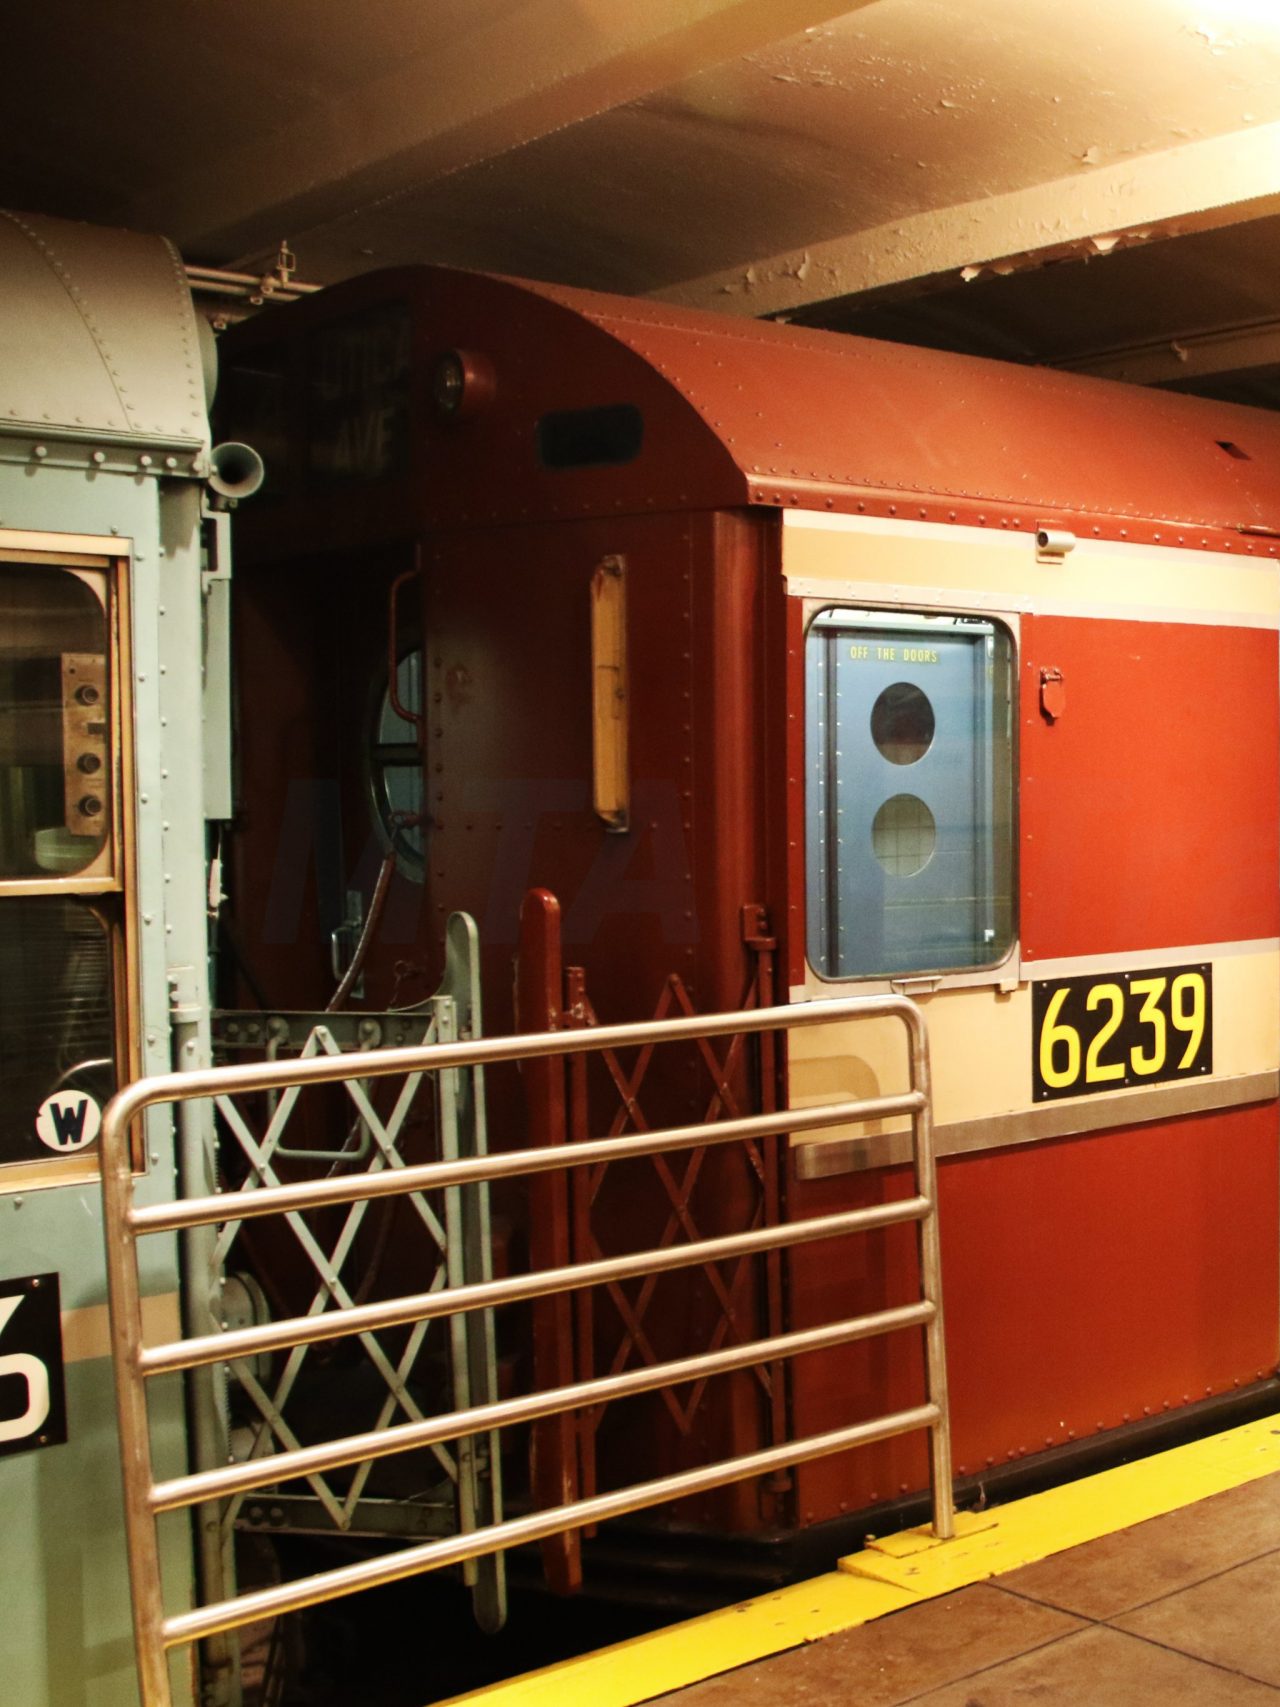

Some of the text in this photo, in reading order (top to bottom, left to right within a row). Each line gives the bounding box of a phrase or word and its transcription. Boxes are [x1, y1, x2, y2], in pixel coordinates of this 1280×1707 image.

[336, 411, 392, 467] AVE
[850, 646, 938, 663] OFF THE DOORS
[1040, 972, 1206, 1088] 6239
[49, 1099, 88, 1145] W
[0, 1295, 51, 1443] 6
